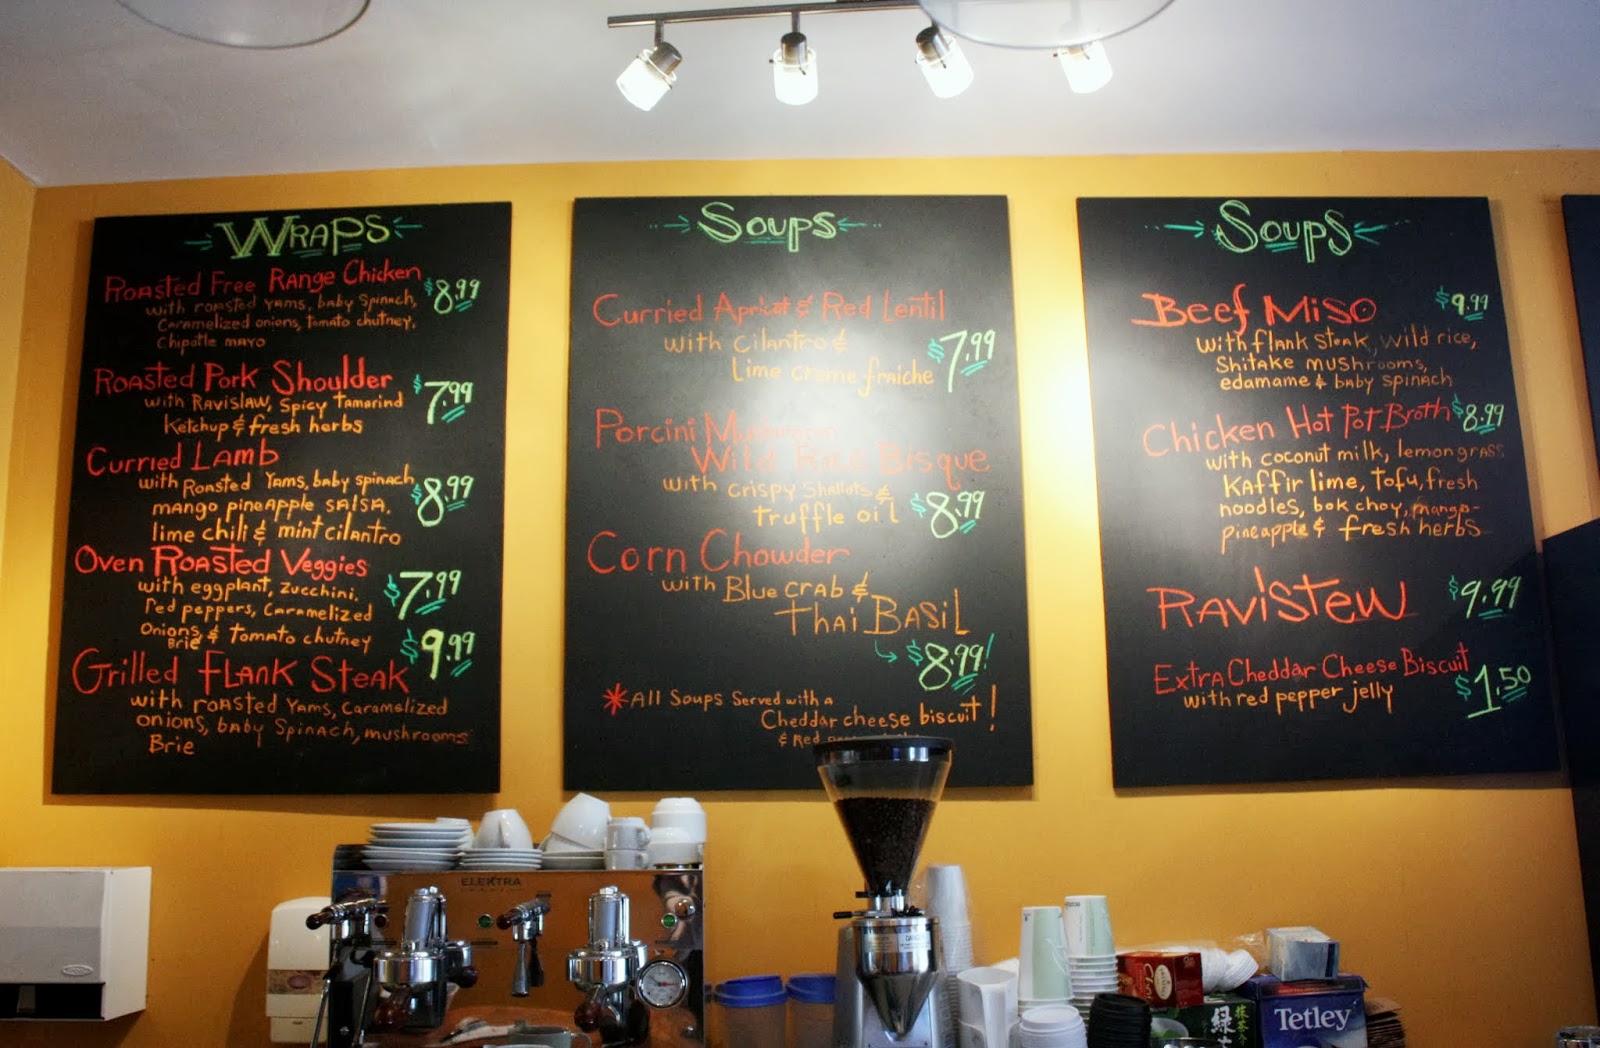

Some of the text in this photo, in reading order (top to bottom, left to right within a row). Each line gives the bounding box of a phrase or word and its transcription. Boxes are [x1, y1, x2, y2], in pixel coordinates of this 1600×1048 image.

[697, 201, 837, 252] Soups
[211, 271, 256, 296] Free
[269, 267, 336, 294] Range
[342, 258, 422, 286] Chicken
[146, 294, 353, 316] with roasted baby
[424, 278, 481, 315] $8.99
[592, 292, 704, 327] Curried
[796, 294, 814, 321] &
[822, 291, 872, 320] Red
[883, 288, 945, 323] Lentil
[1130, 283, 1250, 336] Beef
[1435, 285, 1489, 316] $9.99
[255, 317, 301, 331] onions,
[664, 328, 848, 353] with &
[1196, 331, 1248, 353] with
[1251, 328, 1309, 353] flank
[1437, 328, 1478, 349] rice,
[94, 354, 393, 397] Roasted Pork Shoulder
[858, 356, 935, 397] fraiche
[928, 329, 996, 392] $7.99
[1216, 352, 1294, 374] Shitake
[1220, 366, 1453, 396] edamame & baby spinach
[144, 393, 184, 409] with
[413, 373, 474, 424] $7.99
[1451, 393, 1505, 433] $8.99
[164, 413, 364, 442] Ketchup & fresh herbs
[595, 408, 696, 448] Porcini
[1142, 397, 1450, 457] Chicken Hot Pot Broth
[86, 438, 280, 476] Curried Lamb
[691, 445, 776, 474] Wild
[877, 441, 991, 491] Bisque
[1206, 440, 1390, 471] with coconut milk,
[138, 472, 178, 490] with
[183, 472, 251, 499] Roasted
[312, 469, 349, 494] baby
[662, 474, 717, 492] with
[1223, 469, 1303, 498] Kaffir
[1310, 468, 1366, 492] lime,
[1426, 467, 1478, 491] fresh
[152, 494, 315, 523] mango pineapple
[411, 475, 474, 527] $8.99
[752, 501, 899, 534] truffle oil
[909, 490, 985, 538] $8.99
[1220, 497, 1305, 518] noodles,
[1313, 496, 1349, 513] bok
[1355, 497, 1409, 518] choy,
[152, 511, 401, 547] lime chili & mint cilantro
[1221, 512, 1483, 555] pineapple & fresh herbs
[74, 542, 369, 582] Oven Roasted Veggies
[587, 527, 850, 574] Corn Chowder
[137, 576, 274, 602] with eggplant,
[383, 569, 462, 620] $7.99
[661, 575, 716, 592] with
[722, 573, 779, 602] Blue
[851, 571, 869, 603] &
[1449, 575, 1521, 618] $9.99
[181, 602, 256, 624] peppers,
[168, 636, 201, 650] Brie
[207, 624, 220, 644] &
[303, 626, 372, 654] chutney
[400, 628, 475, 680] $9.99
[72, 647, 179, 694] Grilled
[311, 655, 411, 694] Steak
[1154, 641, 1469, 695] Extra Cheddar Cheese Biscuit
[130, 688, 183, 709] with
[193, 691, 277, 714] roasted
[630, 689, 661, 709] All
[670, 688, 724, 712] Soups
[785, 688, 819, 706] with
[823, 695, 834, 706] a
[1183, 680, 1393, 716] with red pepper jelly
[1454, 664, 1532, 718] $1.50
[136, 710, 209, 736] onions,
[217, 716, 264, 748] baby
[364, 723, 470, 745] mushrooms
[761, 705, 911, 730] Cheddar cheese
[150, 733, 195, 756] Brie
[778, 731, 787, 747] &
[461, 876, 522, 886] ELEKTRA
[1274, 1005, 1351, 1031] Tetley
